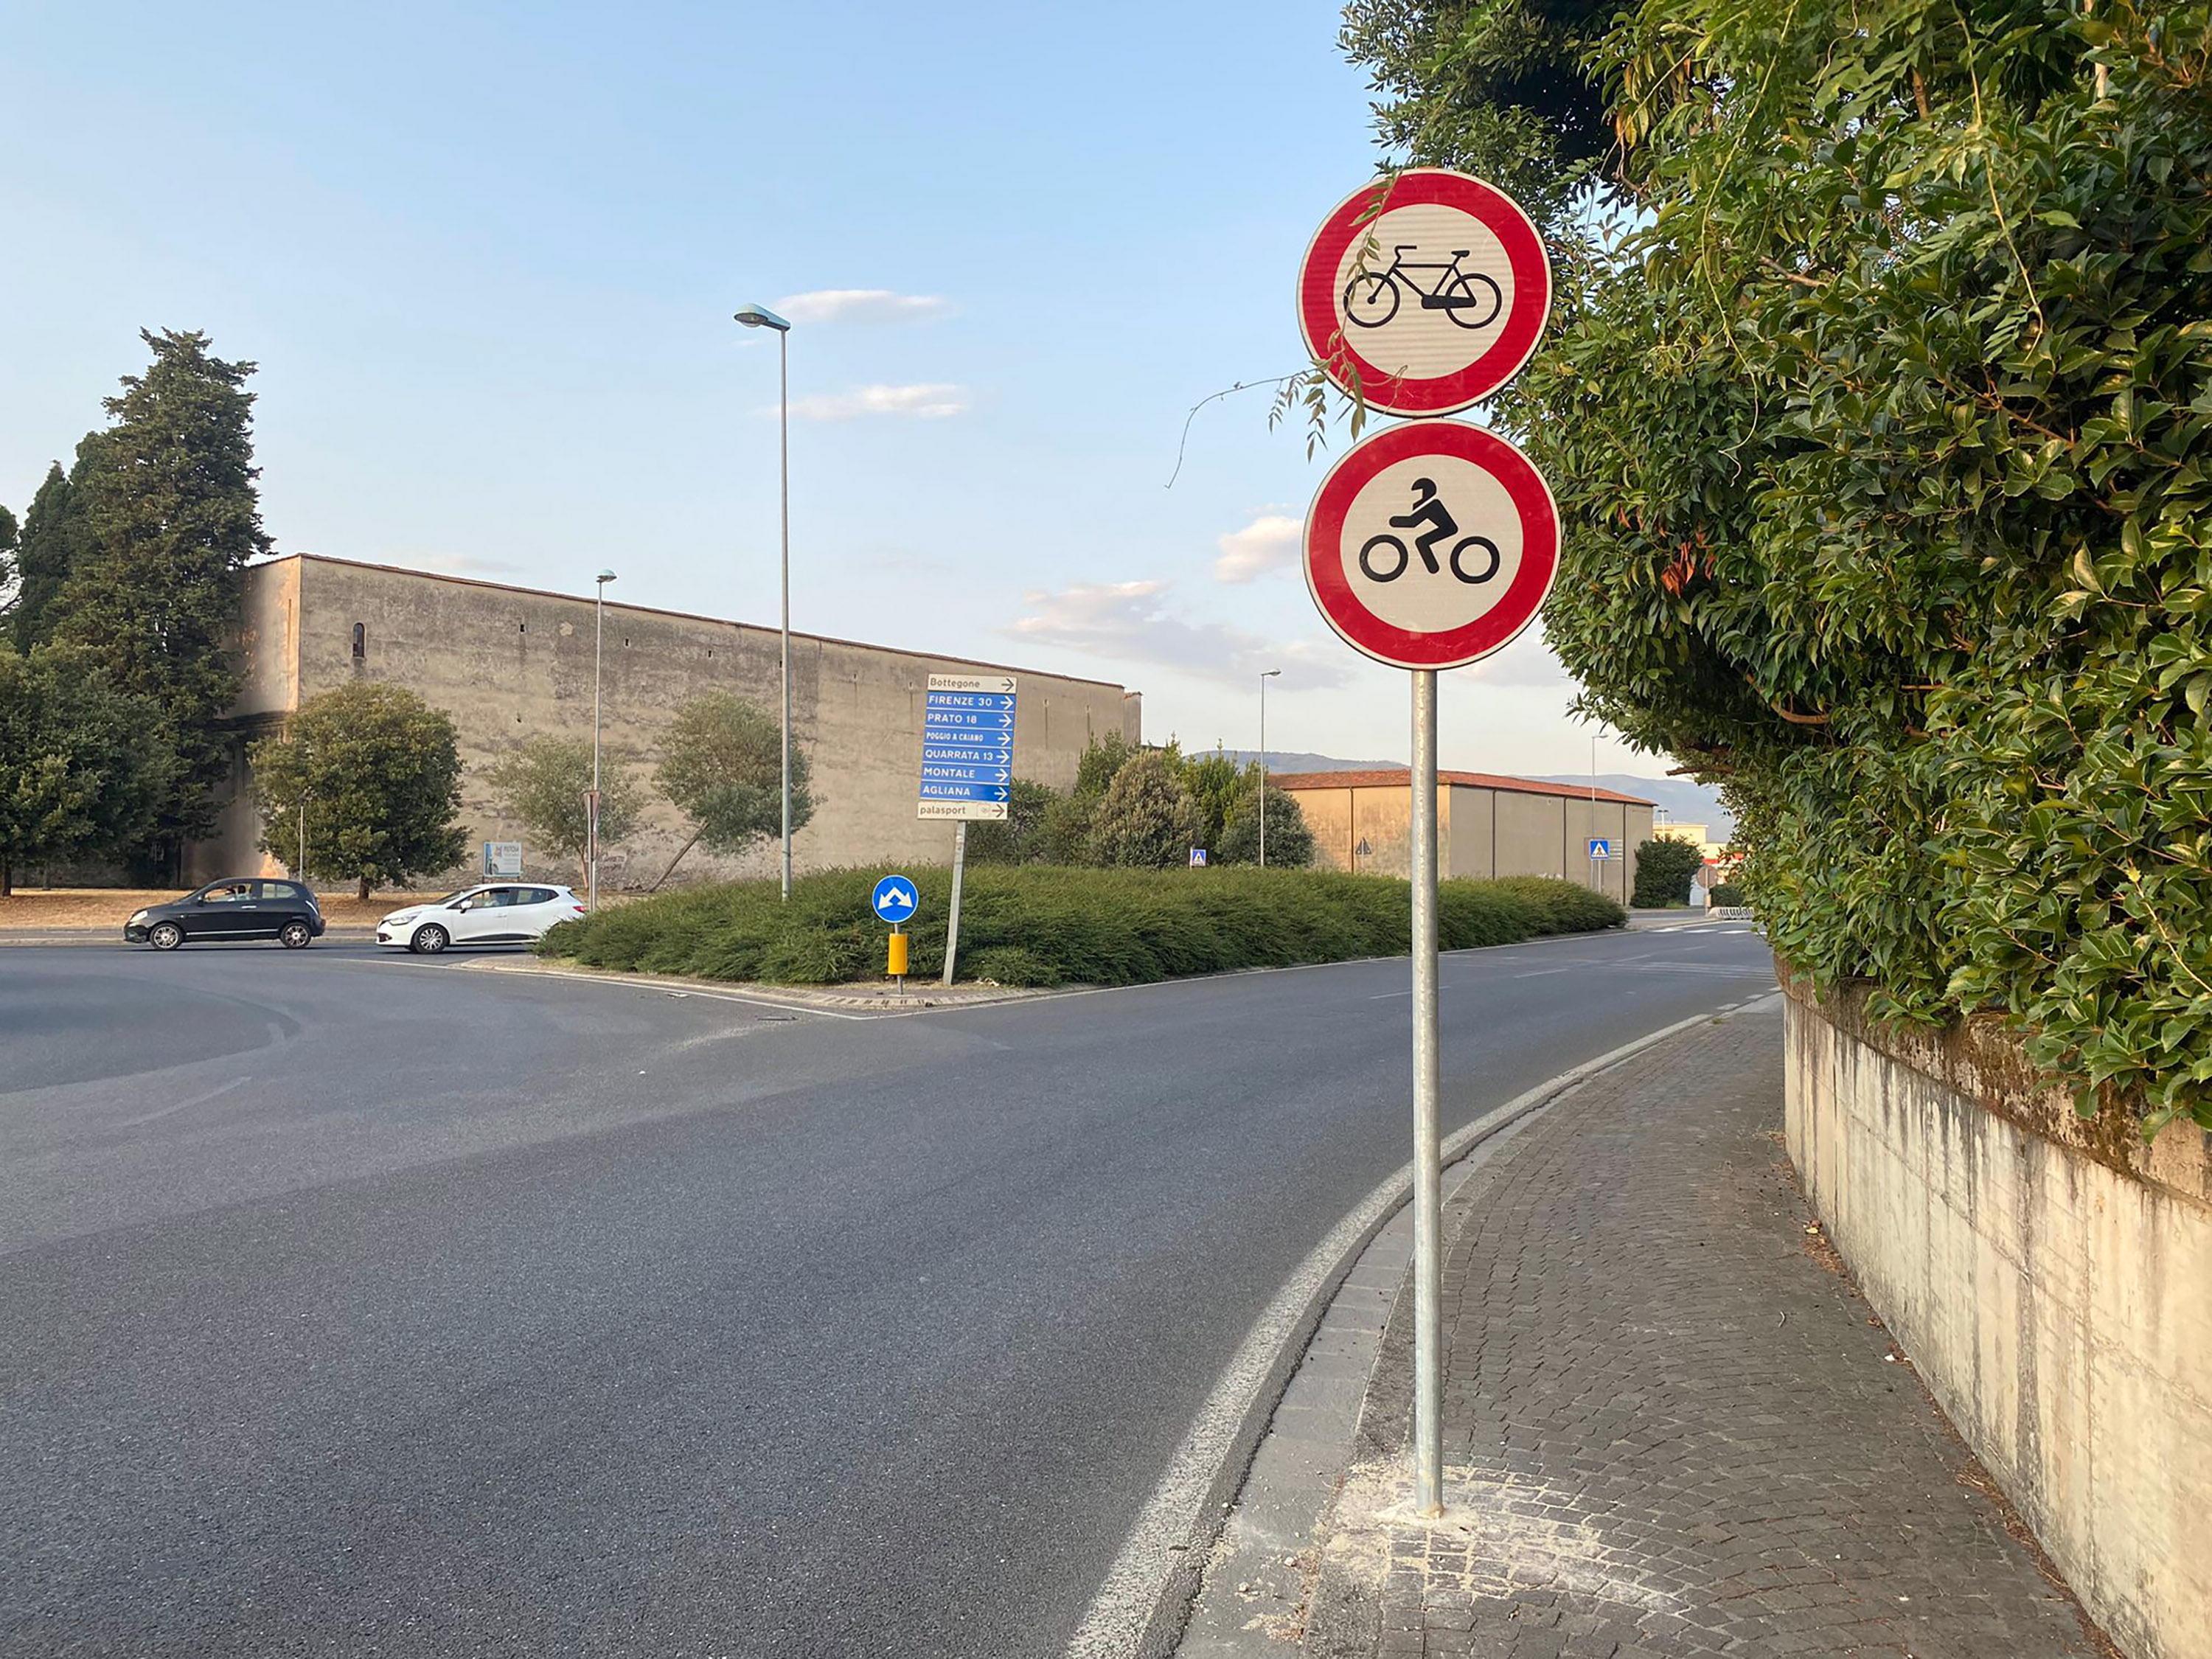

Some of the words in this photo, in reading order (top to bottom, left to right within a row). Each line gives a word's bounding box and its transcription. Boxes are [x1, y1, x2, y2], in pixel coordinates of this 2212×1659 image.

[930, 678, 980, 688] Bottegone
[928, 695, 974, 706] FIRENZE
[978, 698, 992, 706] 30
[927, 713, 962, 723] PRATO
[966, 715, 977, 724] 18
[926, 732, 951, 741] POGGIO
[953, 733, 957, 741] A
[959, 733, 984, 742] CAIANO
[925, 749, 980, 760] QUARRATA
[983, 751, 993, 761] 13
[923, 767, 975, 778] MONTALE
[922, 785, 970, 796] AGLIANA
[920, 806, 966, 815] palasport
